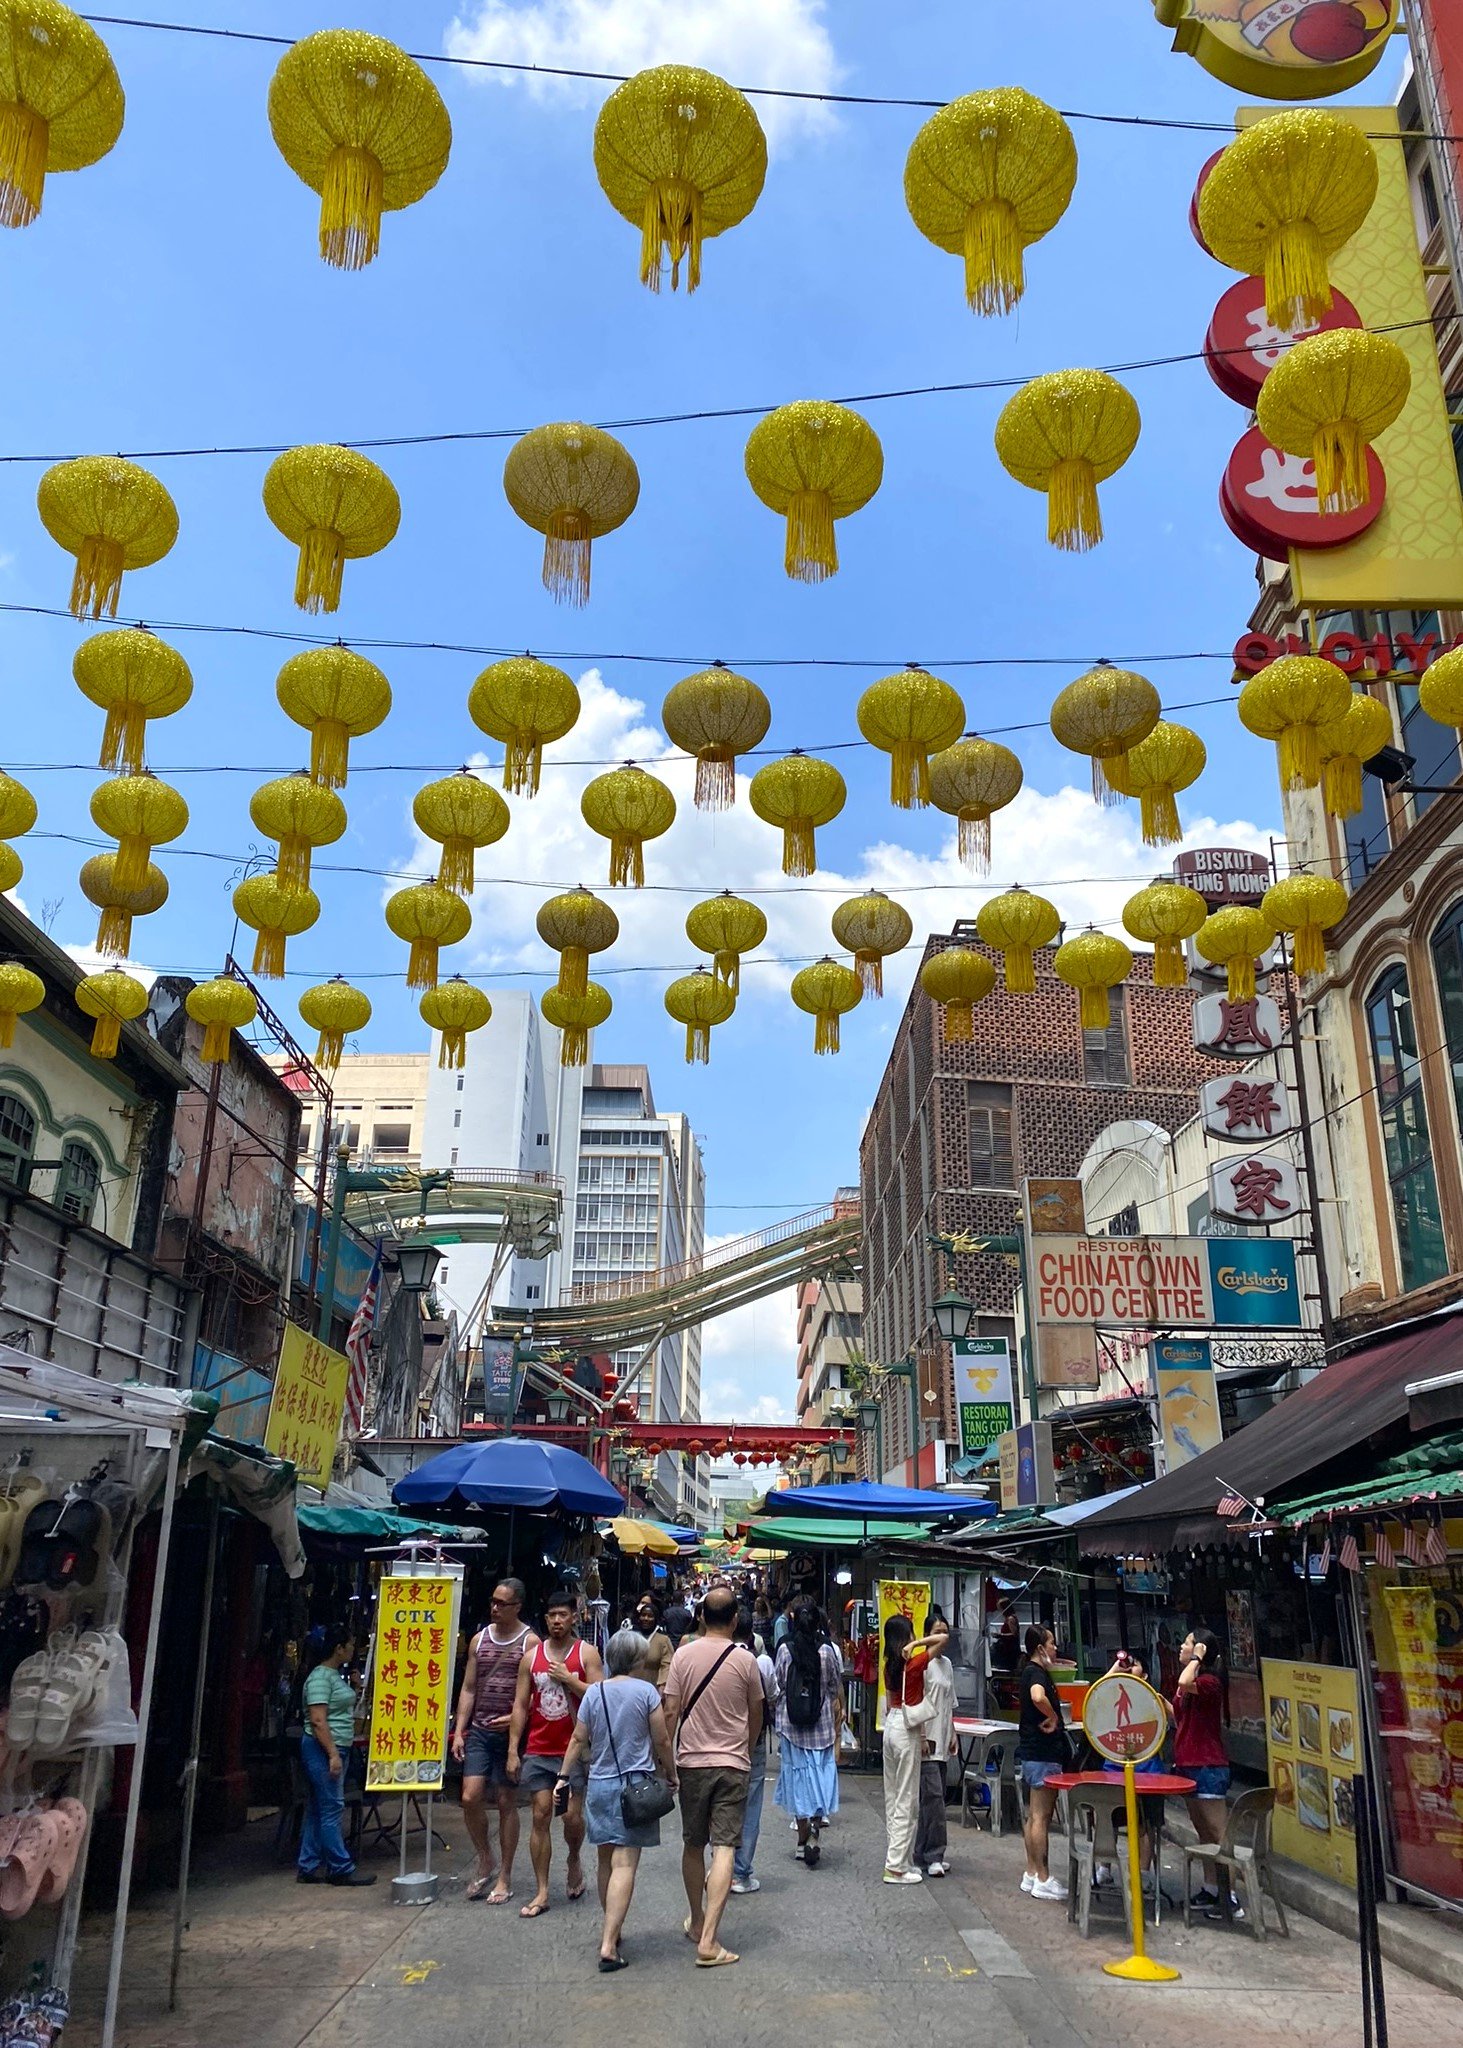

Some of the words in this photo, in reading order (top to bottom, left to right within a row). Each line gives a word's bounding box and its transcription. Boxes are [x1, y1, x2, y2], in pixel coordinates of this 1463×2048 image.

[1194, 851, 1254, 870] BISKUT
[1183, 872, 1224, 892] FUNG
[1227, 873, 1270, 895] WONG
[1077, 1242, 1162, 1252] RESTORAN
[1039, 1253, 1201, 1288] CHINATOWN
[1217, 1267, 1288, 1294] Carlsberg
[1039, 1286, 1105, 1318] FOOD
[1112, 1288, 1206, 1319] CENTRE
[1162, 1346, 1203, 1362] Carlsberg
[964, 1405, 1008, 1420] RESTORAN
[965, 1421, 988, 1434] TANG
[991, 1420, 1009, 1434] CITY
[966, 1436, 986, 1447] FOOD
[395, 1610, 436, 1623] CTK
